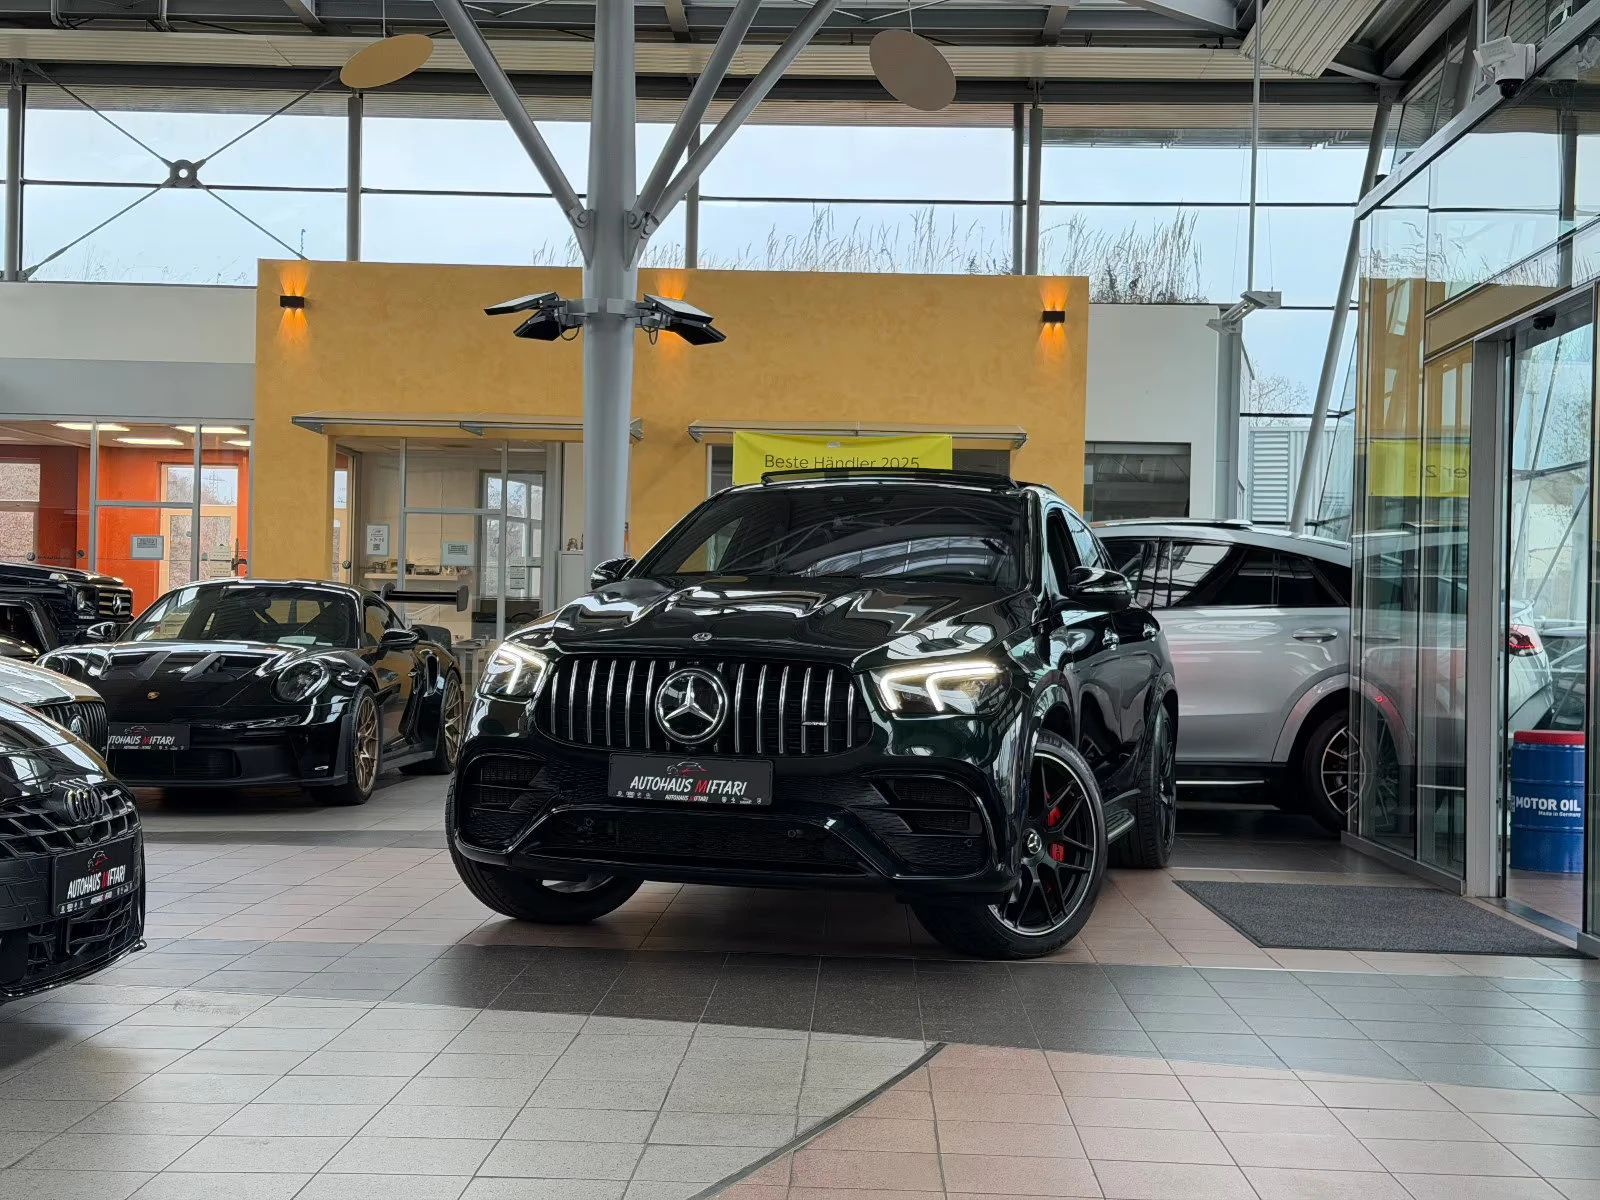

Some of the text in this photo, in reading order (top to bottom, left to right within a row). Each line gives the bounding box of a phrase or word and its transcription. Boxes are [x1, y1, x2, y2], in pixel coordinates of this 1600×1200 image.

[764, 454, 920, 469] Beste Händler 2025
[107, 735, 176, 745] UTOHAUS MIFTARI
[630, 775, 748, 796] AUTOHAUS MIFTARI
[1515, 796, 1557, 810] MOTOR
[1560, 799, 1581, 811] OIL
[67, 872, 101, 899] AUTOHAUS
[101, 865, 125, 888] MIFTARI
